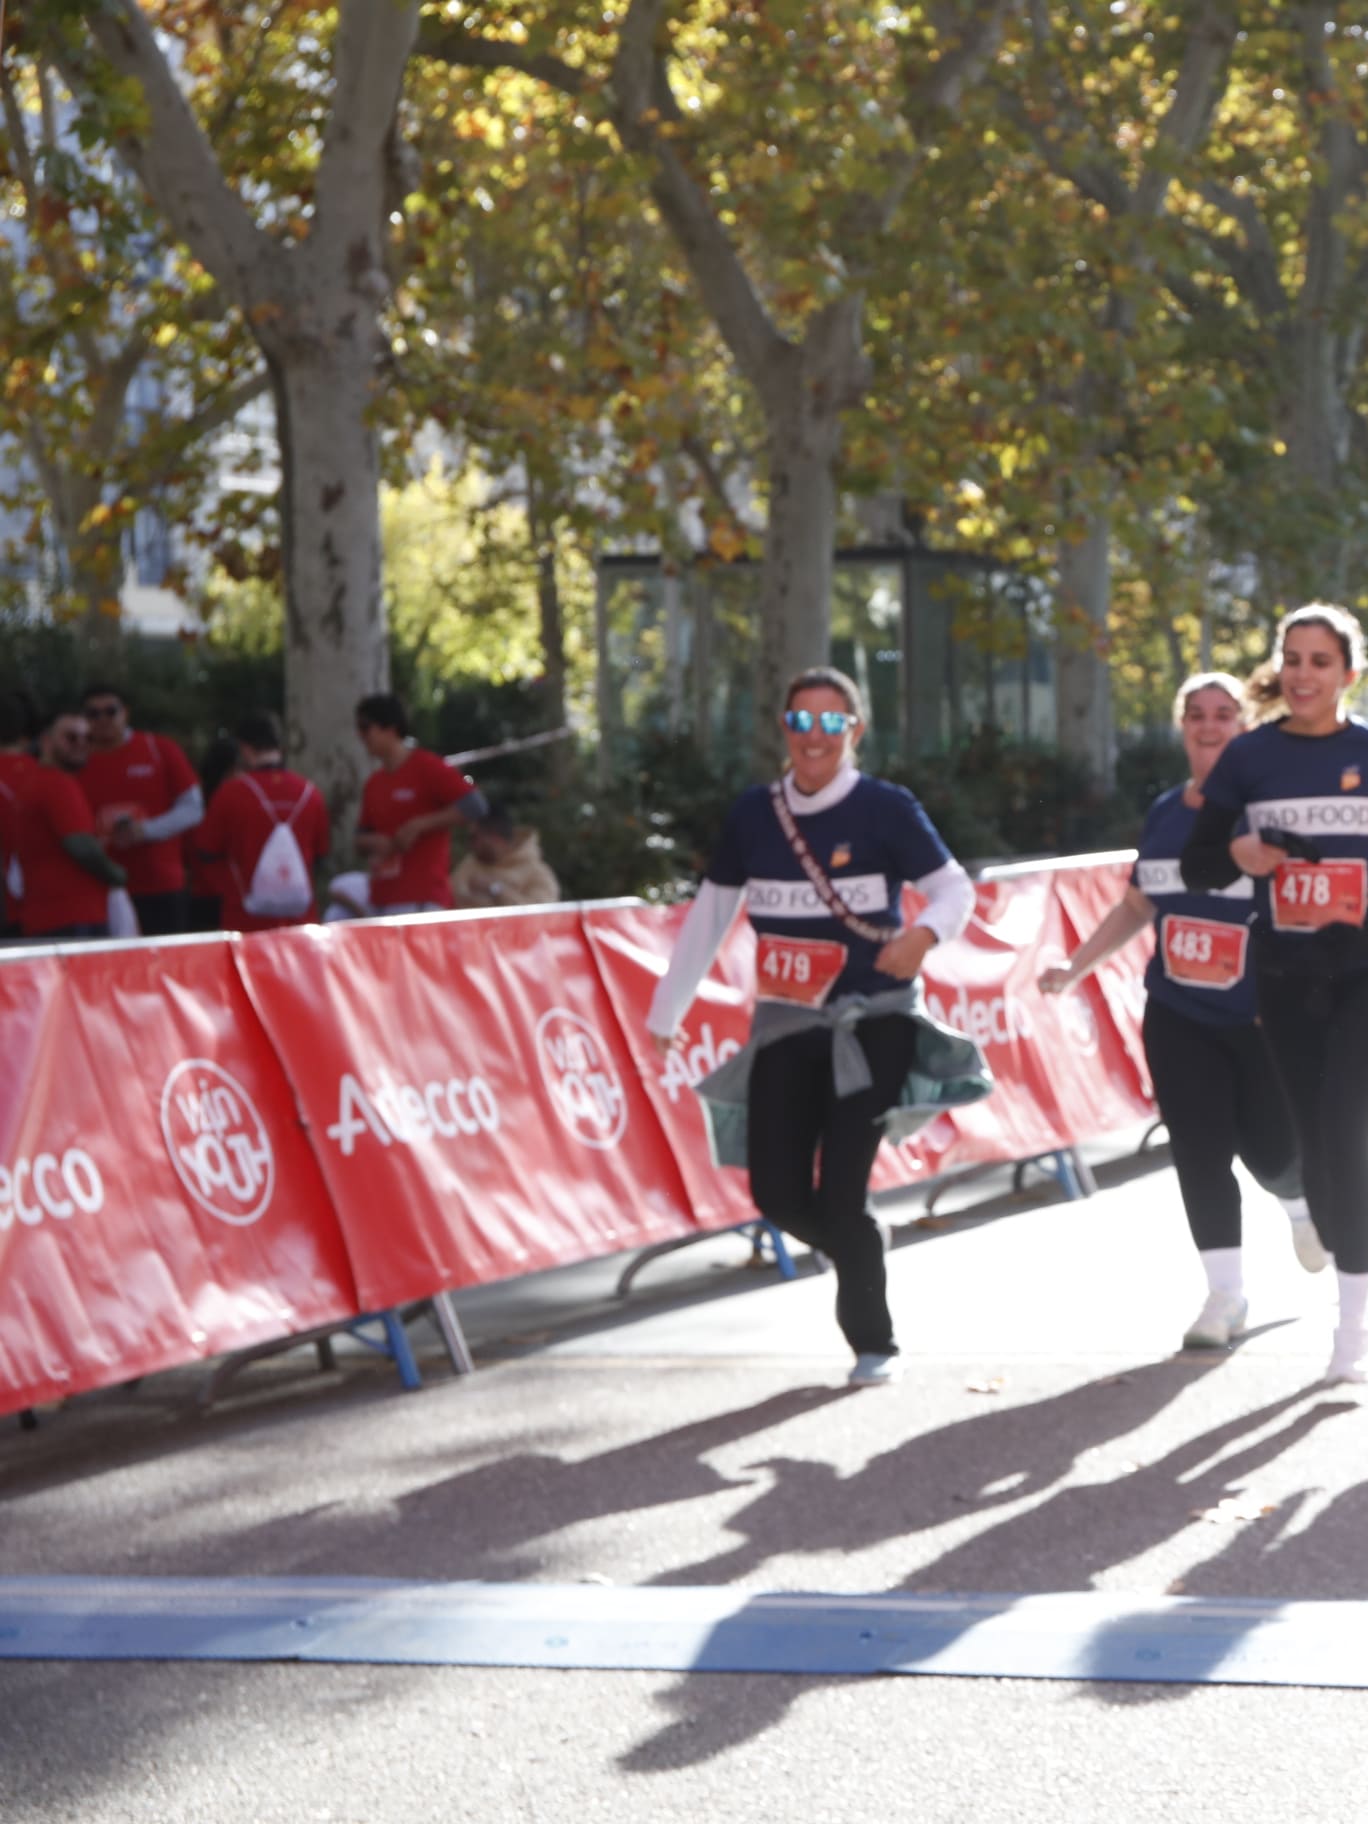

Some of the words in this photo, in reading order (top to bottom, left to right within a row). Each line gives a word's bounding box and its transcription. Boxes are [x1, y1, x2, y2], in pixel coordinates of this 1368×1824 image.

[1281, 874, 1330, 906] 478
[1170, 930, 1212, 962] 483
[763, 950, 811, 982] 479
[327, 1069, 498, 1156] Adecco
